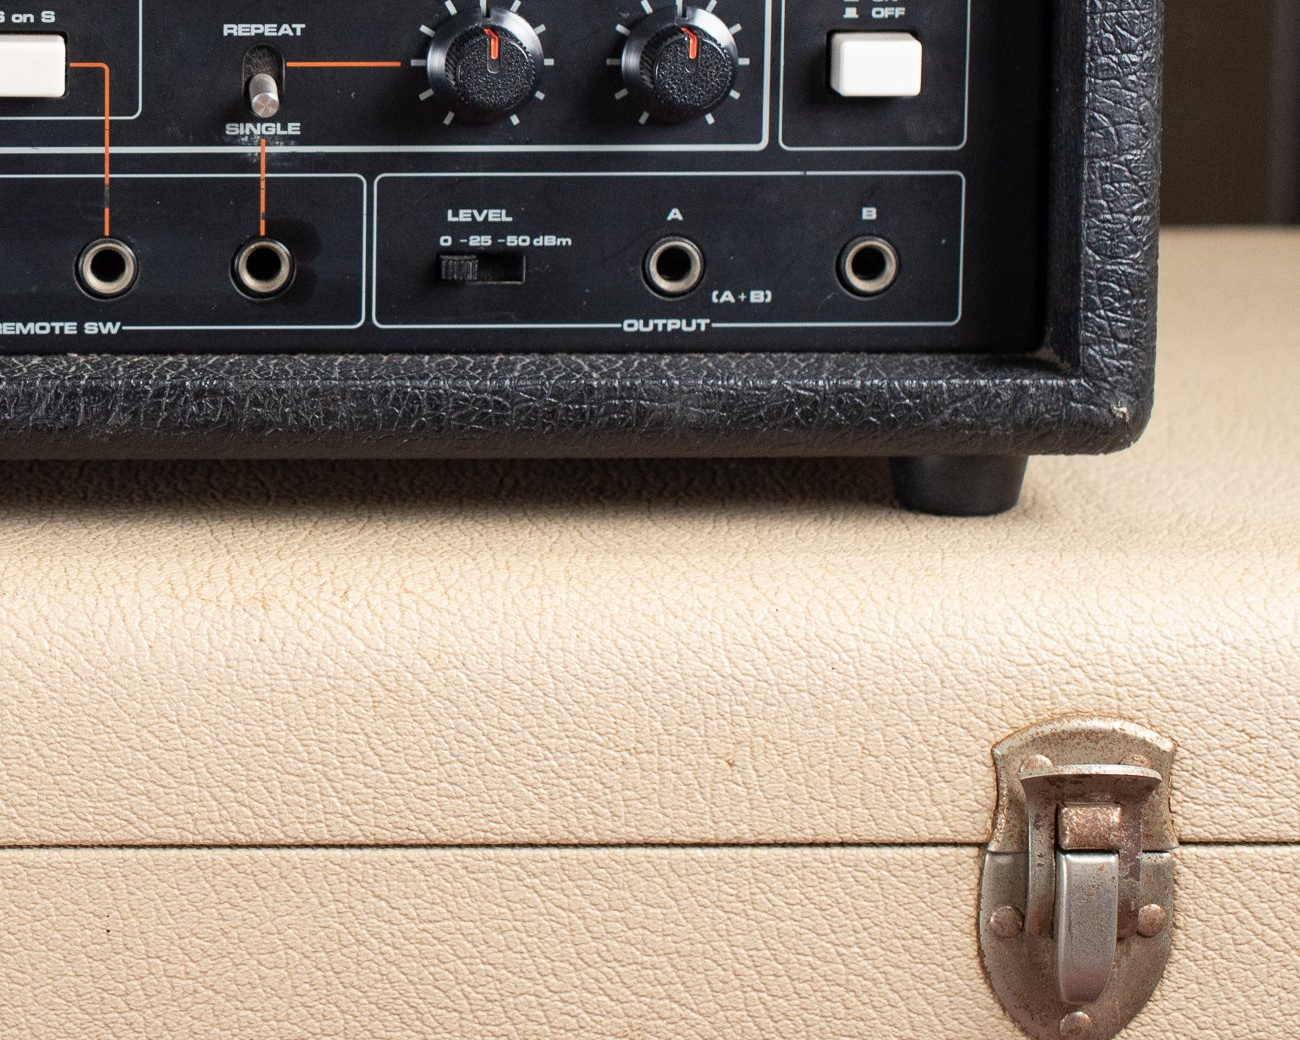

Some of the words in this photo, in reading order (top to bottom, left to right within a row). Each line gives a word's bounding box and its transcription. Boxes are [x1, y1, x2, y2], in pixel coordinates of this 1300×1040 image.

[11, 13, 35, 24] on
[40, 10, 56, 24] S
[871, 6, 906, 19] OFF
[222, 23, 306, 37] REPEAT
[225, 122, 301, 136] SINGLE
[447, 208, 513, 222] LEVEL
[666, 207, 684, 221] A
[861, 206, 877, 220] B
[84, 321, 121, 335] SW
[622, 319, 711, 333] OUTPUT
